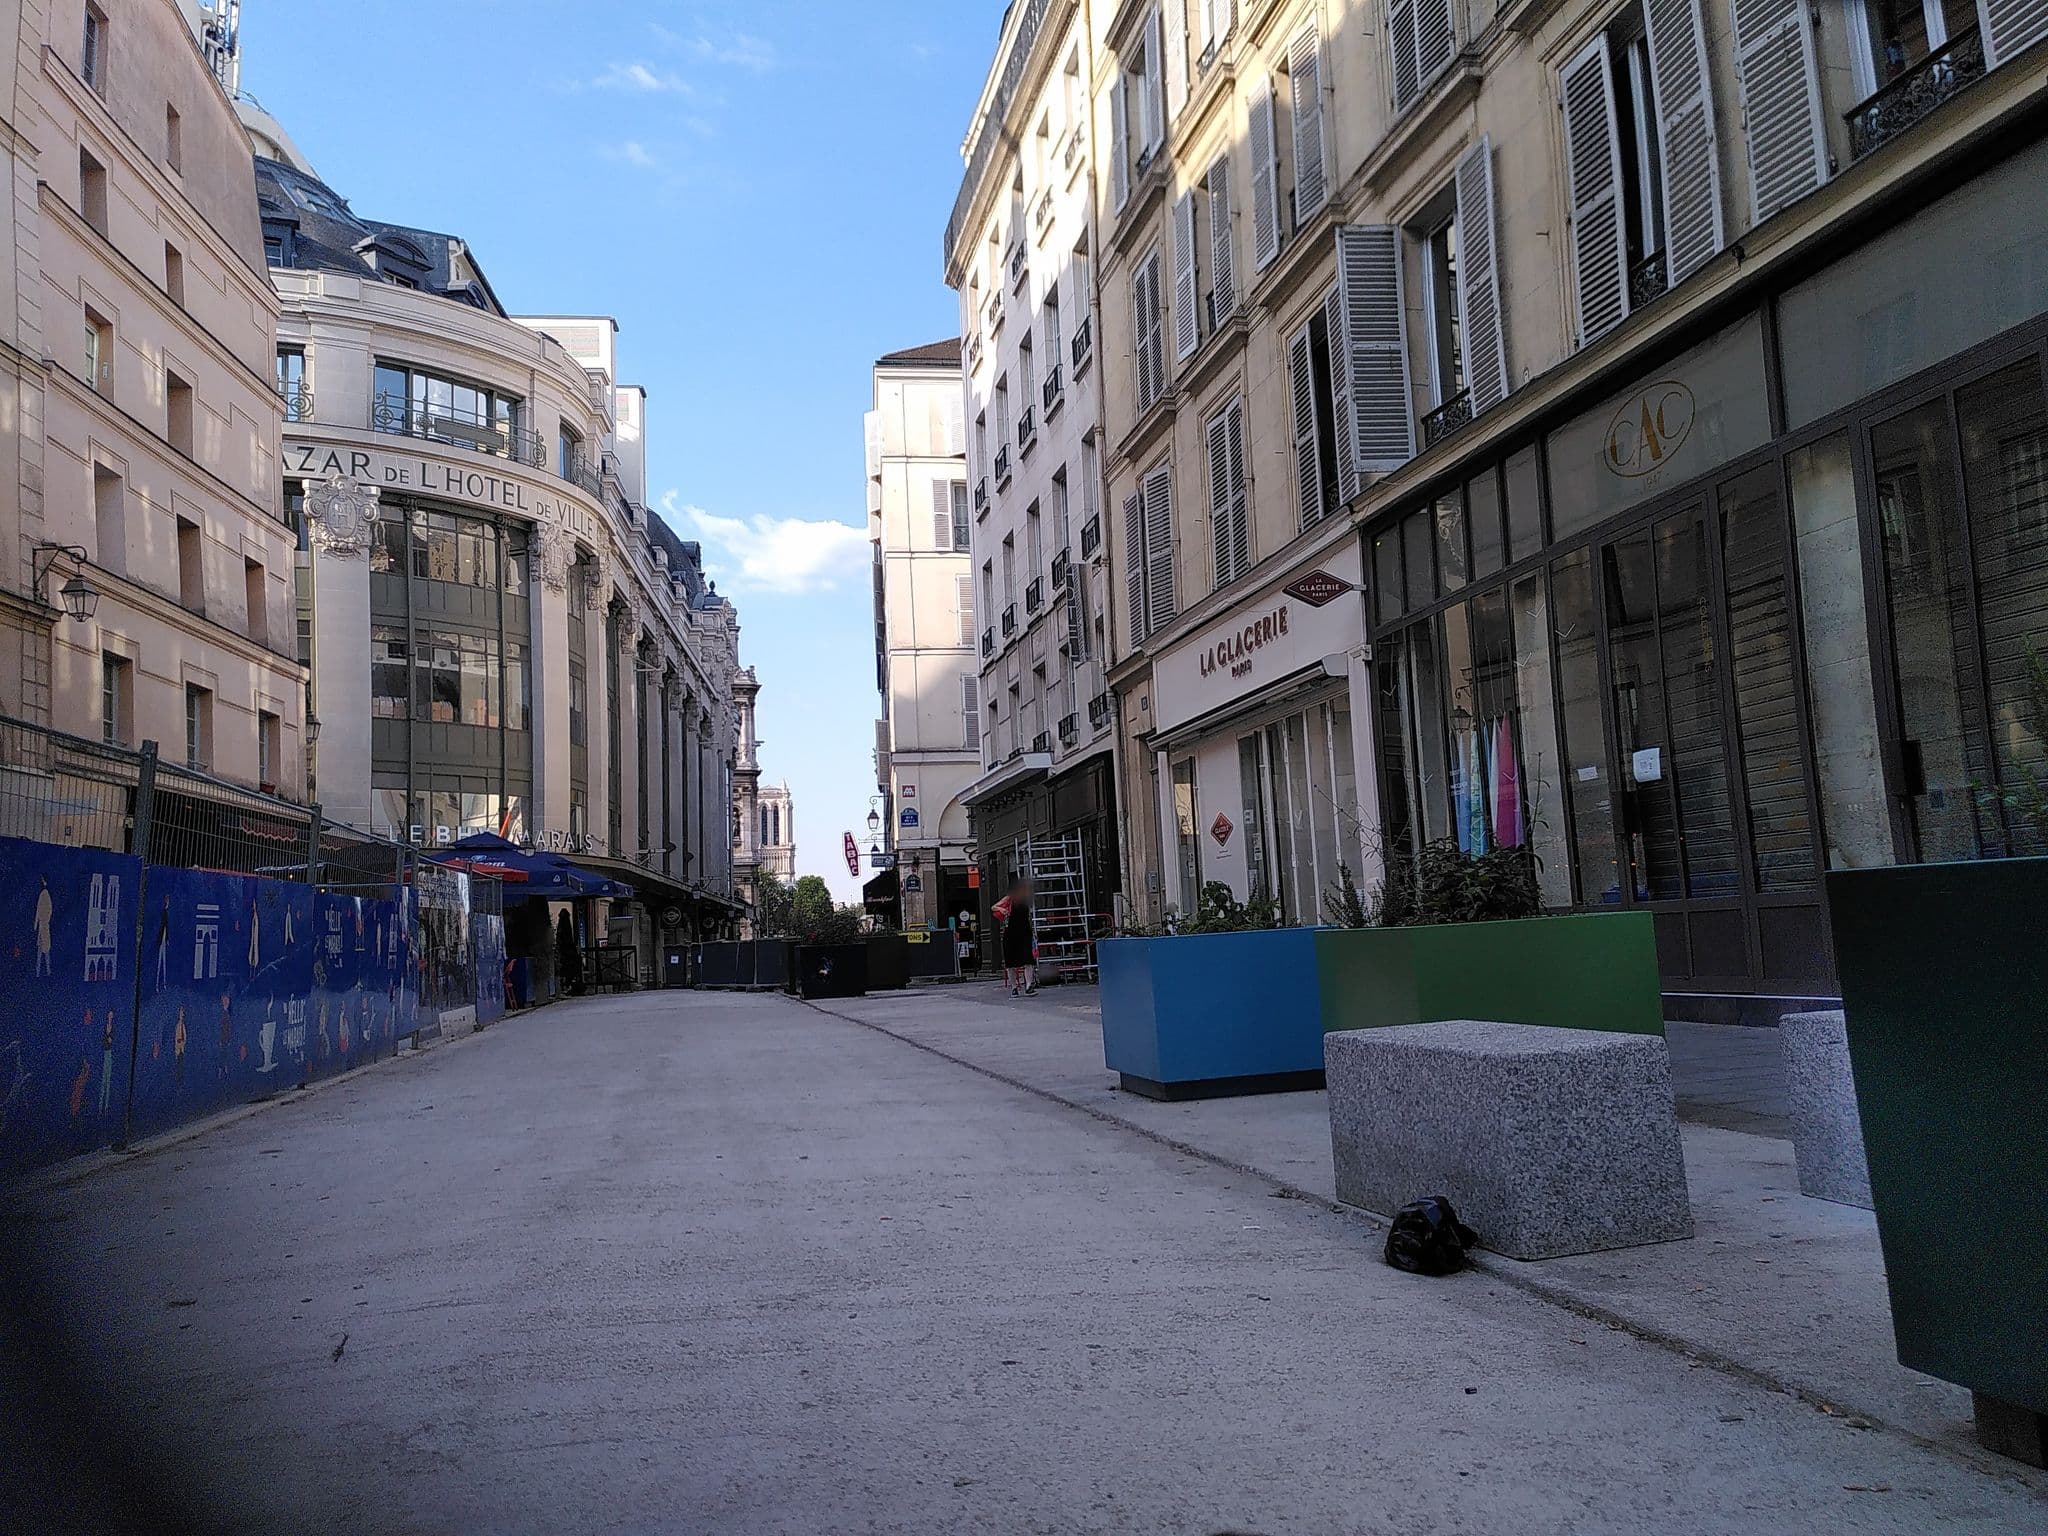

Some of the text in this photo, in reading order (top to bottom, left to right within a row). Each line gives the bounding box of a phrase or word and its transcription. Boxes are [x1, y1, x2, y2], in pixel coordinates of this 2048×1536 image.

[384, 466, 410, 485] DE
[420, 462, 529, 511] L'HOTEL
[535, 501, 551, 519] DE
[554, 499, 594, 541] VILLE
[1299, 583, 1340, 592] GLACERIE
[1200, 606, 1288, 677] LA GLACERIE
[1231, 658, 1253, 678] PARIS
[389, 825, 423, 843] LE
[844, 833, 858, 875] TABAC
